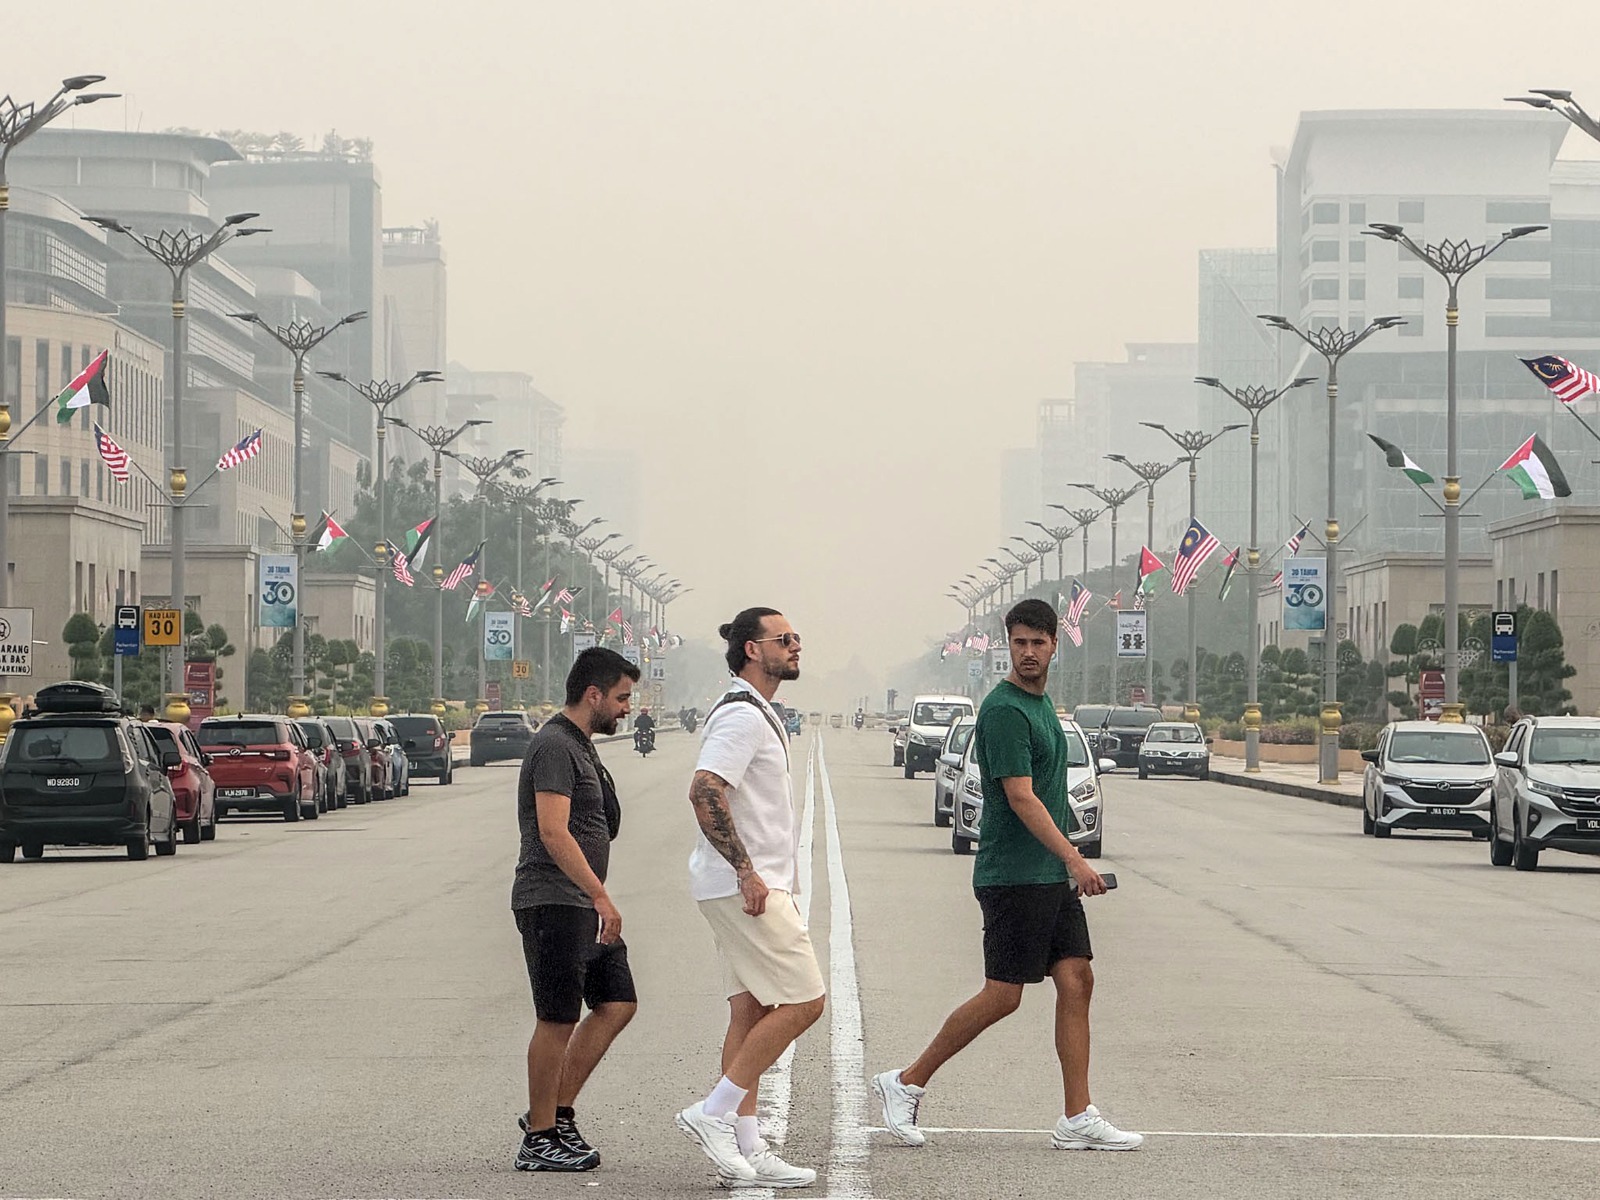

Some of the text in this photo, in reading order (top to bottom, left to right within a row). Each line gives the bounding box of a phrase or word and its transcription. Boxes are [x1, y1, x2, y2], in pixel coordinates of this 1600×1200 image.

[262, 581, 295, 605] 30
[1285, 583, 1323, 608] 30
[151, 620, 173, 636] 30
[487, 629, 511, 645] 30
[10, 655, 26, 664] BAS
[1586, 819, 1600, 829] VDL
